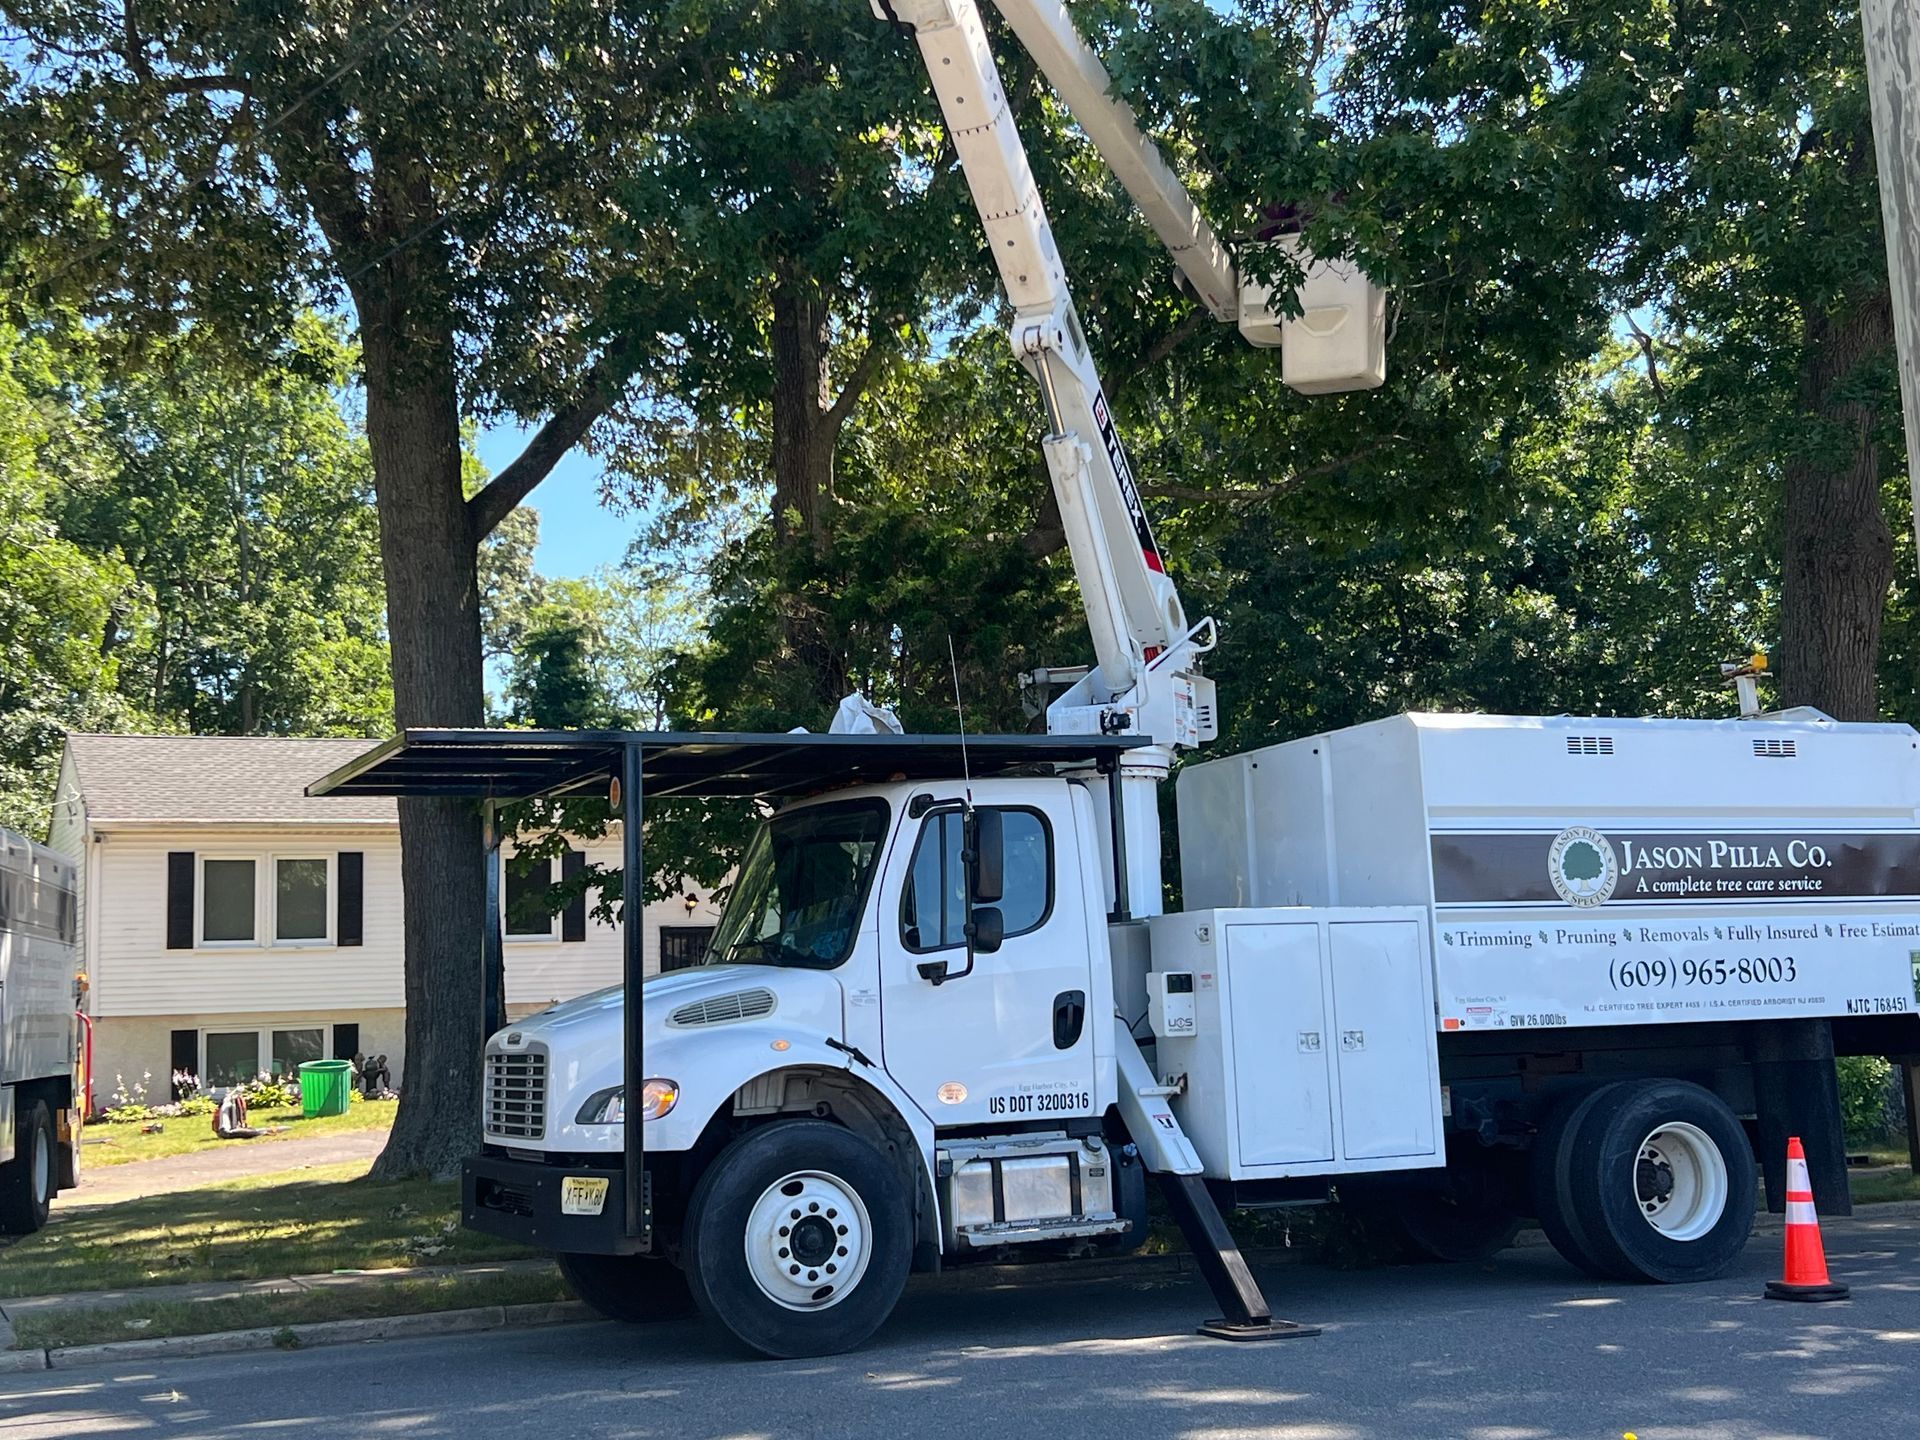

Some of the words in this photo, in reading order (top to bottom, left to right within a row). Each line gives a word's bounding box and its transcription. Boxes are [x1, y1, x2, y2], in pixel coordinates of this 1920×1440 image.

[1108, 429, 1142, 528] TEREX
[1554, 829, 1580, 853] JASON
[1571, 868, 1615, 906] SPECIALIST
[1636, 876, 1649, 893] A
[1652, 875, 1712, 895] complete
[1716, 878, 1742, 892] tree
[1746, 878, 1774, 891] care
[1778, 875, 1823, 891] service
[1456, 930, 1533, 949] Trimming
[1555, 928, 1617, 947] Pruning
[1639, 926, 1709, 943] Removals
[1727, 924, 1762, 943] Fully
[1767, 923, 1819, 941] Insured
[1839, 922, 1868, 938] Free
[1609, 957, 1677, 991] (609)
[1682, 956, 1797, 986] 965-8003
[1599, 1003, 1635, 1012] CERTIFIED
[1636, 1002, 1655, 1010] TREE
[1656, 1001, 1683, 1010] EXPERT
[1728, 999, 1761, 1007] CERTIFIED
[1763, 997, 1796, 1006] ARBORIST
[1846, 998, 1871, 1014] NJTC
[1874, 996, 1908, 1013] 768451
[1510, 1014, 1525, 1027] GVW
[990, 1096, 1005, 1114] US
[1010, 1094, 1033, 1113] DOT
[1037, 1092, 1089, 1111] 3200316
